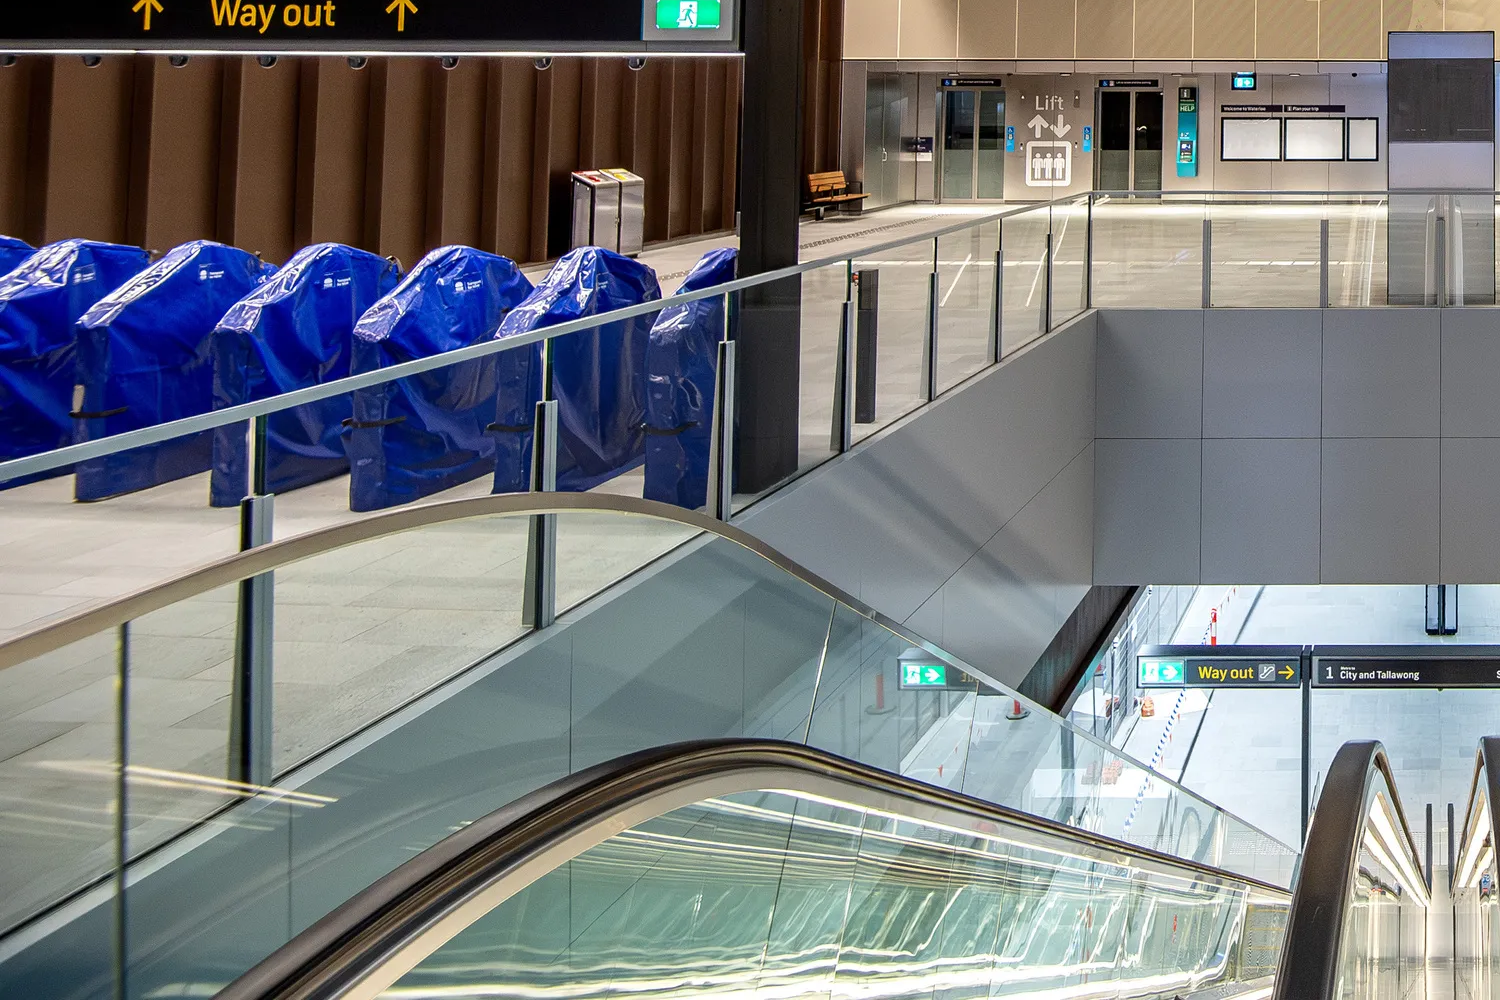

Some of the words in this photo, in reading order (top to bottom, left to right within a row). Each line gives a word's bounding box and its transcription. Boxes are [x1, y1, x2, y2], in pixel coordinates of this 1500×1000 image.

[283, 0, 336, 27] out
[1035, 95, 1064, 111] Lift
[1198, 666, 1227, 682] Way
[1230, 667, 1254, 679] out
[1326, 666, 1334, 679] 1
[1340, 671, 1357, 681] City
[1358, 670, 1375, 679] and
[1376, 671, 1420, 681] Tallawong
